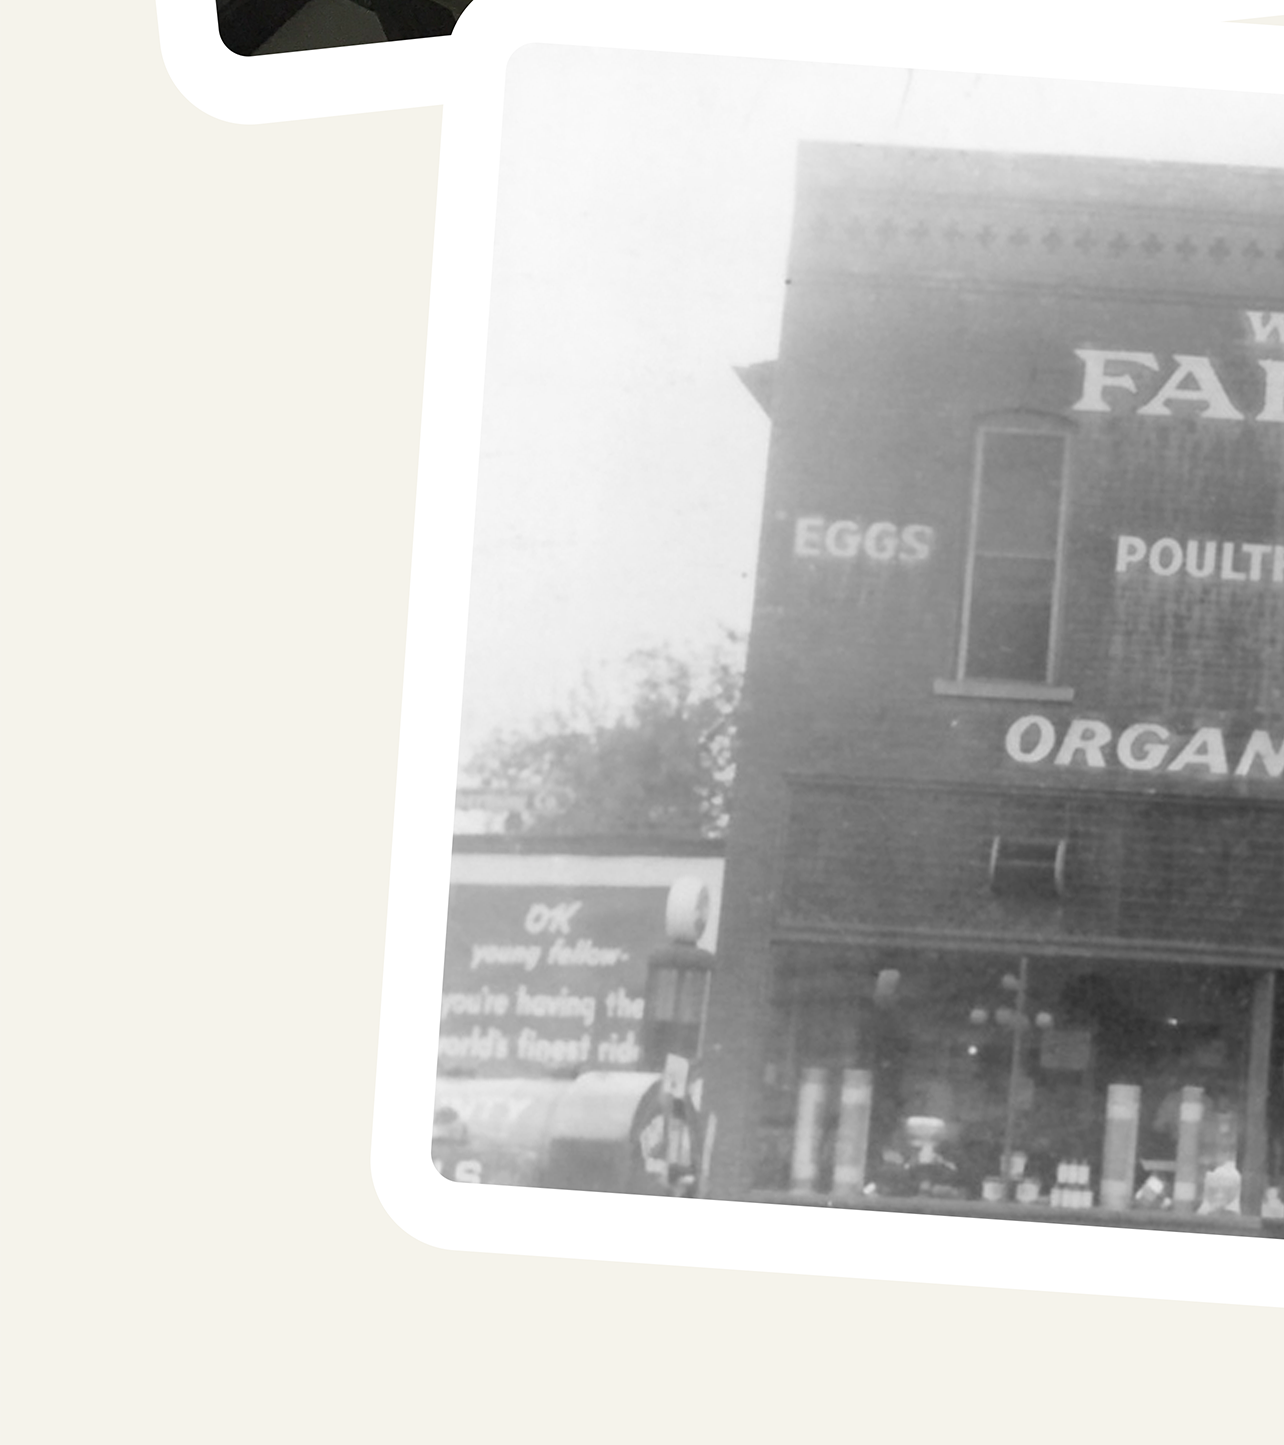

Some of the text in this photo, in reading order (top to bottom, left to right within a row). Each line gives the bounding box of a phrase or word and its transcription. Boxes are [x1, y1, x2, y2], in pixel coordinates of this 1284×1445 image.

[793, 517, 934, 561] EGGS
[524, 901, 582, 935] OK
[470, 944, 542, 971] young
[516, 985, 596, 1027] having
[606, 987, 645, 1019] the
[517, 1027, 591, 1070] finest
